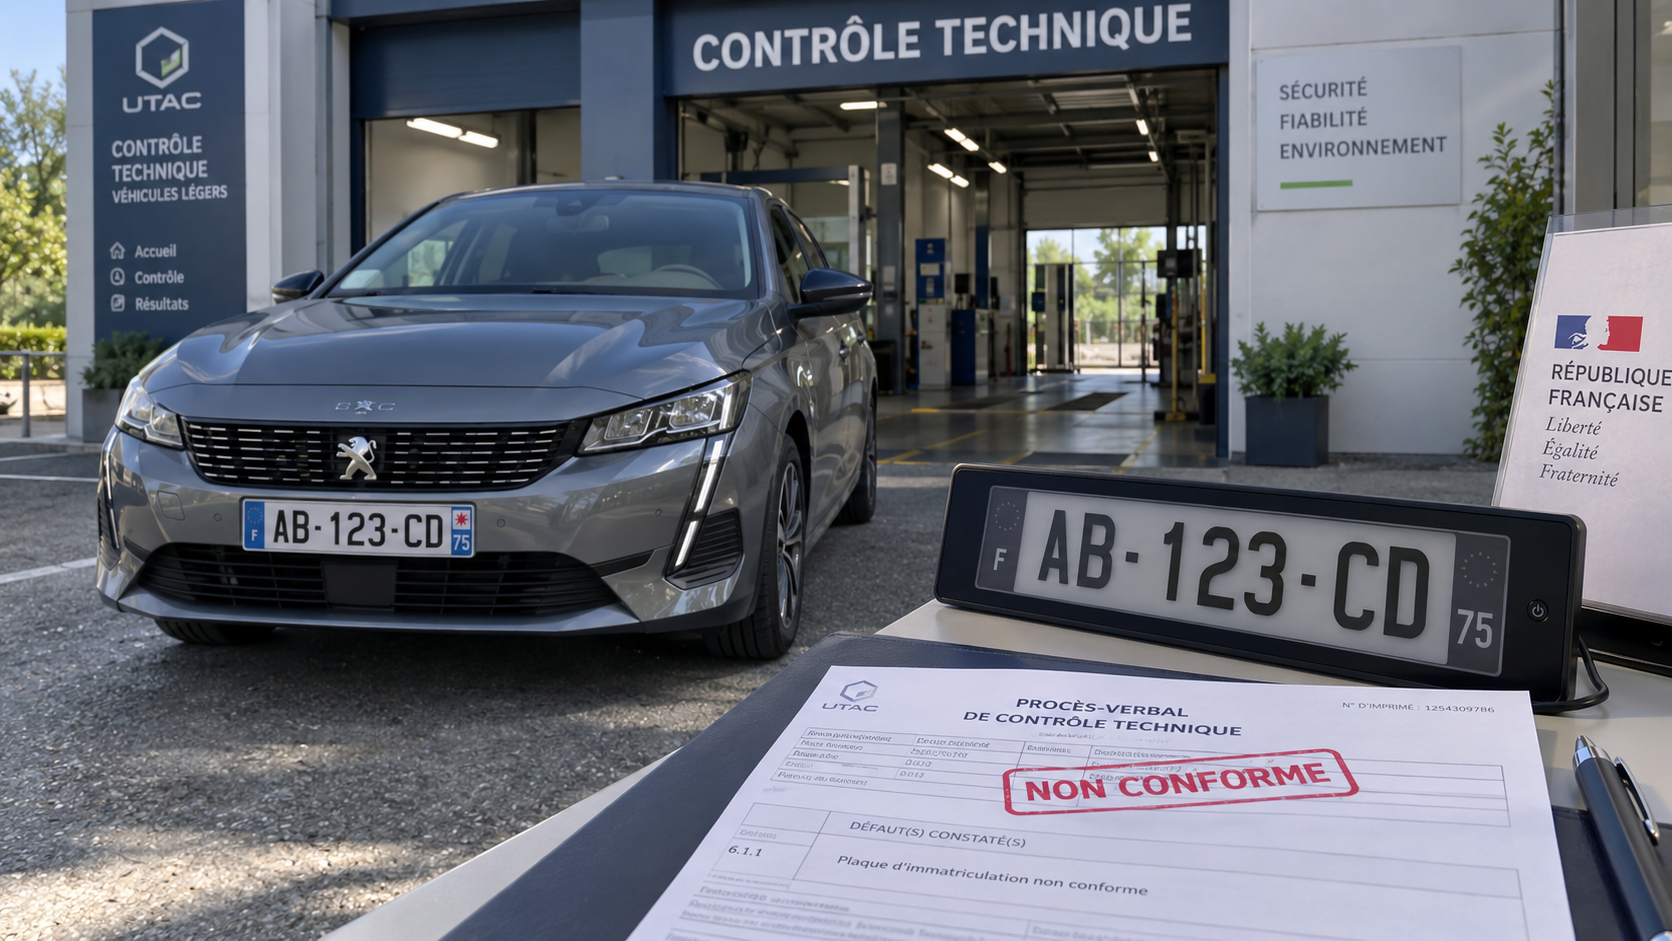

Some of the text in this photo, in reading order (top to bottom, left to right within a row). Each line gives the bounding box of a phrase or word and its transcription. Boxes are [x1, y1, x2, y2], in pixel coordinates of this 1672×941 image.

[693, 3, 1192, 71] CONTRÔLE TECHNIQUE
[1279, 76, 1368, 101] SÉCURITÉ
[122, 92, 202, 113] UTAC
[1280, 106, 1368, 130] FIABILITÉ
[111, 133, 203, 158] CONTRÔLE
[1280, 136, 1448, 159] ENVIRONNEMENT
[111, 160, 208, 182] TECHNIQUE
[112, 184, 228, 203] VÉHICULES LÉGERS
[134, 244, 177, 258] Accueil
[134, 270, 185, 284] Contrôle
[135, 297, 189, 311] Résultats
[1551, 360, 1672, 387] RÉPUBLIQUE
[1549, 389, 1664, 413] FRANÇAISE
[1545, 416, 1602, 436] Liberté
[1542, 438, 1600, 461] Égalité
[1539, 463, 1620, 487] Fraternité
[251, 509, 470, 551] F AB-123-CD 75
[993, 509, 1494, 649] F AB-123-CD 75
[822, 703, 878, 712] UTAC
[1016, 698, 1189, 717] PROCÈS-VERBAL
[1358, 703, 1414, 711] D'IMPRIMÉ
[1425, 705, 1495, 713] 1254309786
[963, 711, 1242, 736] DE CONTRÔLE TECHNIQUE
[1025, 779, 1107, 803] NON
[1118, 762, 1332, 797] CONFORME
[850, 821, 1027, 848] DÉFAUT(S) CONSTATÉ(S)
[728, 845, 763, 857] 6.1.1
[837, 855, 1149, 896] Plaque d'immatriculation non conforme
